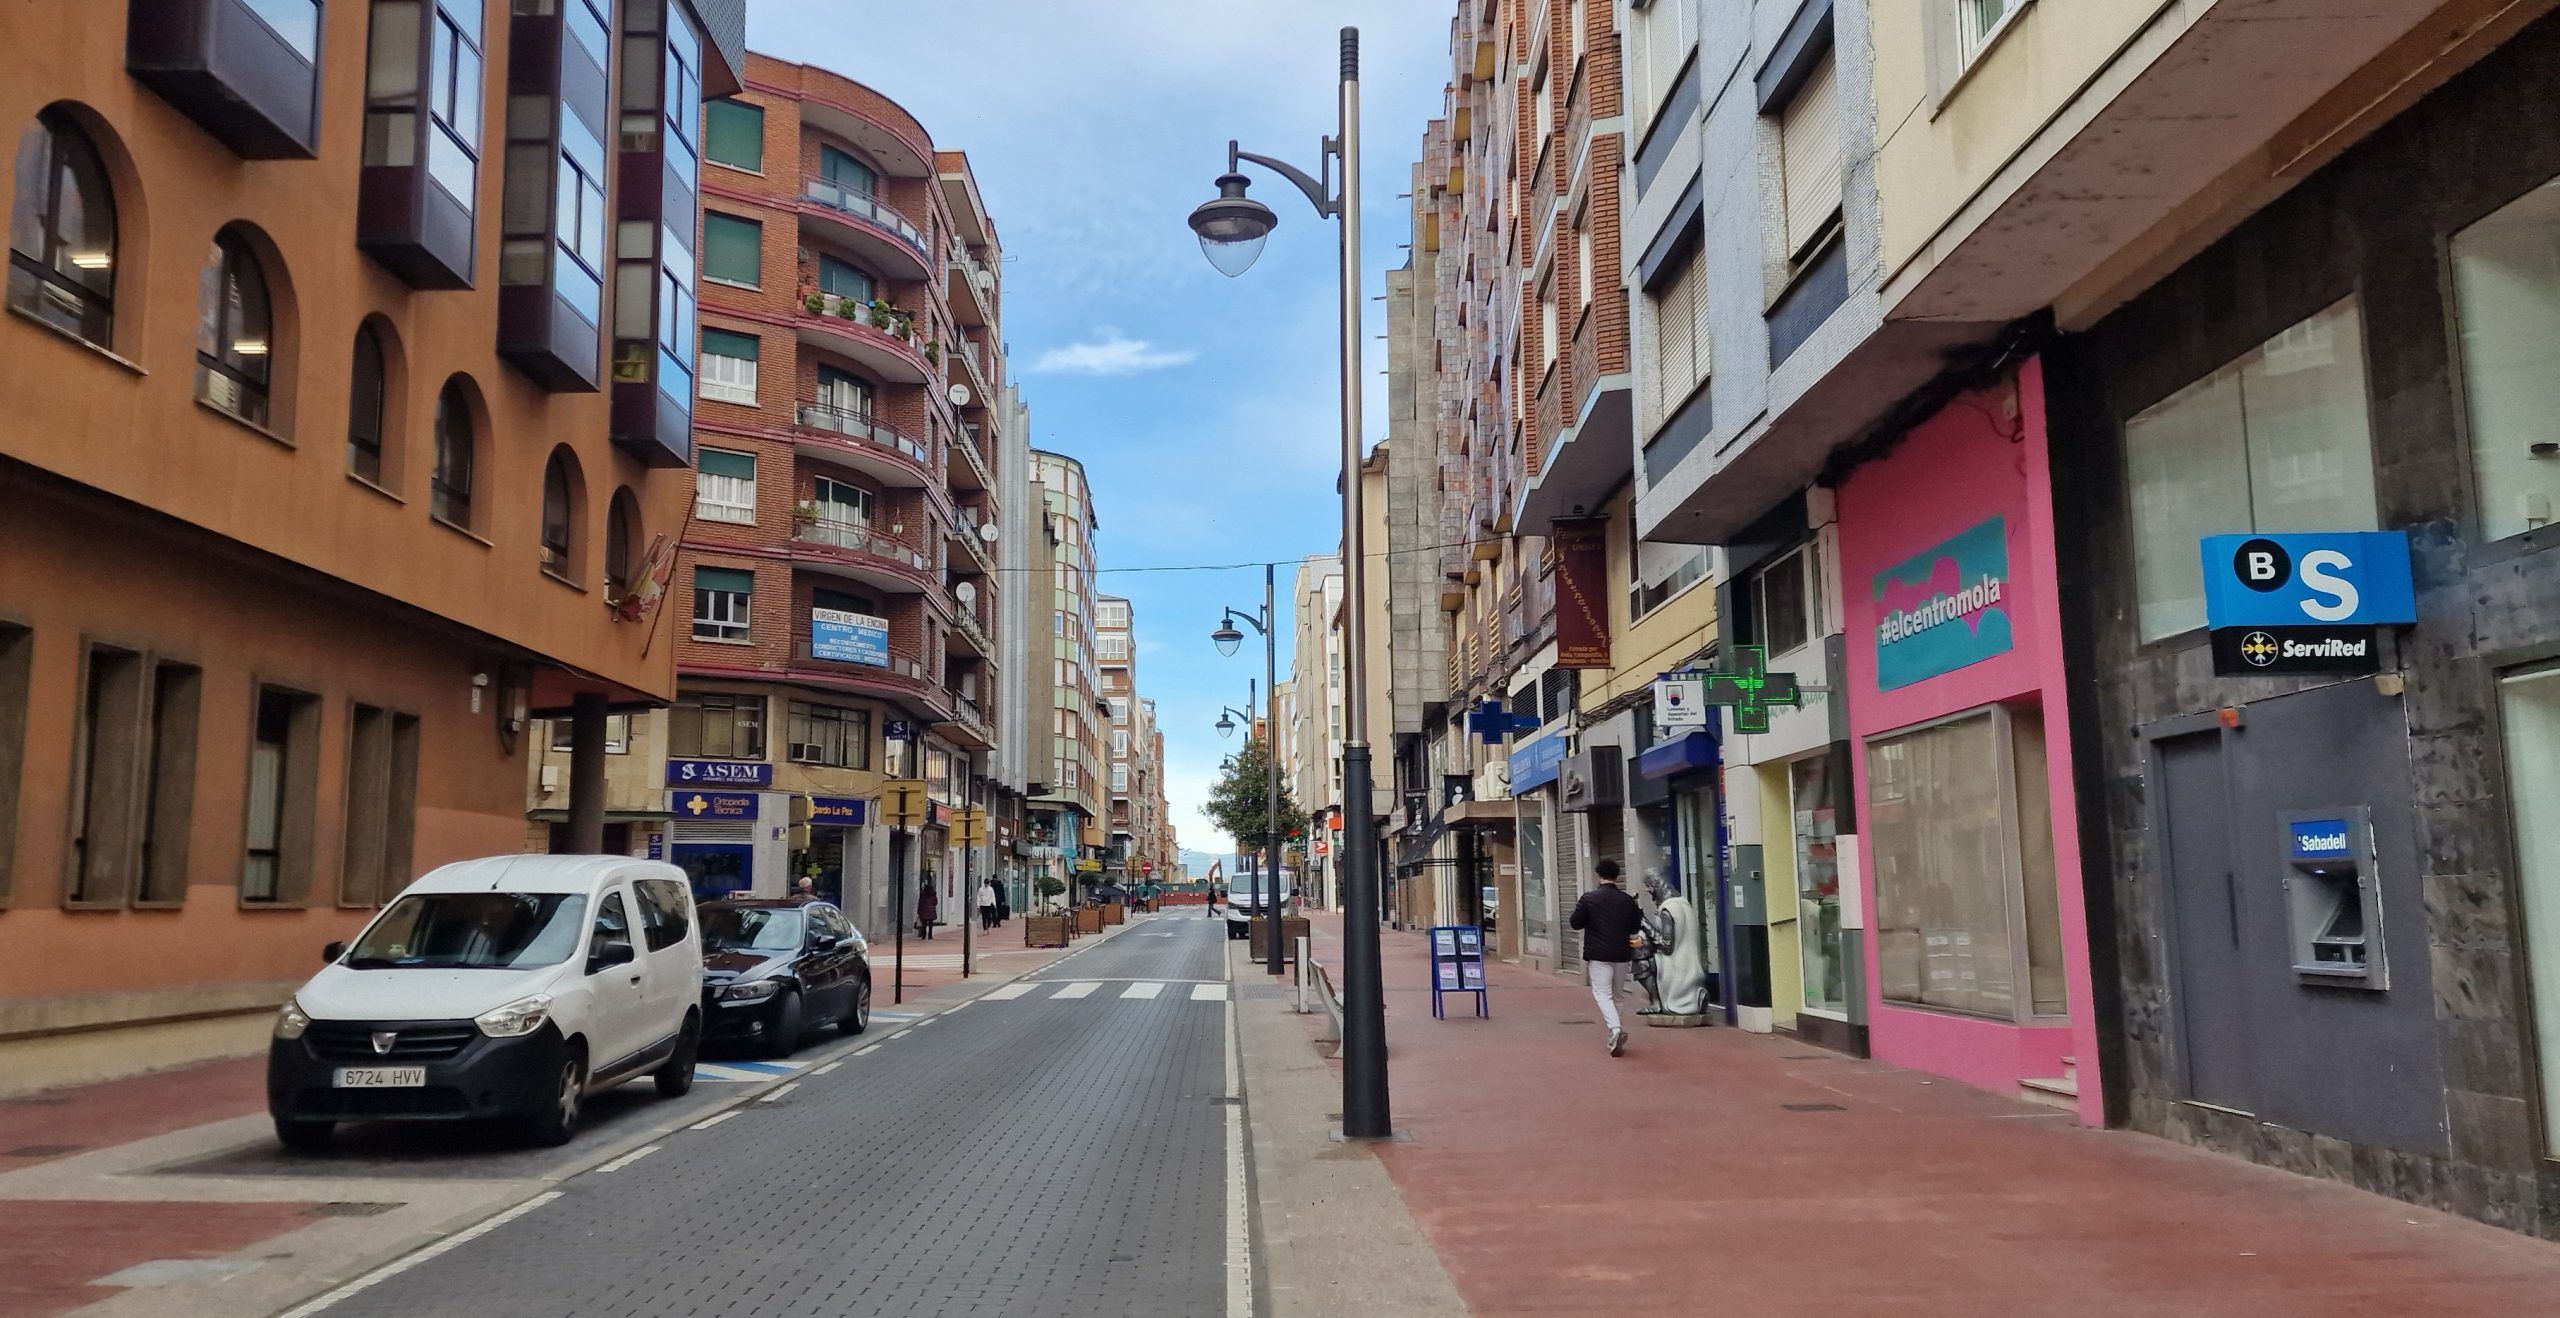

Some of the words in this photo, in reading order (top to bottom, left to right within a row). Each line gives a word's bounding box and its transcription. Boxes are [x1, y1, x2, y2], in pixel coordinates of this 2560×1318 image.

[2248, 552, 2276, 580] B
[2299, 550, 2359, 621] S
[1881, 573, 2001, 646] #elcentromola
[814, 610, 841, 622] VIRGEN
[843, 614, 853, 624] DE
[856, 616, 864, 625] LA
[867, 618, 887, 629] ENCINA
[821, 623, 853, 633] CENTRO
[2283, 638, 2366, 658] ServiRed
[702, 764, 760, 778] ASEM
[713, 797, 749, 806] Ortopedia
[832, 806, 841, 815] La
[842, 807, 853, 816] Paz
[2302, 832, 2347, 852] Sabadell
[345, 1070, 384, 1086] 6724
[393, 1070, 422, 1085] HVV
